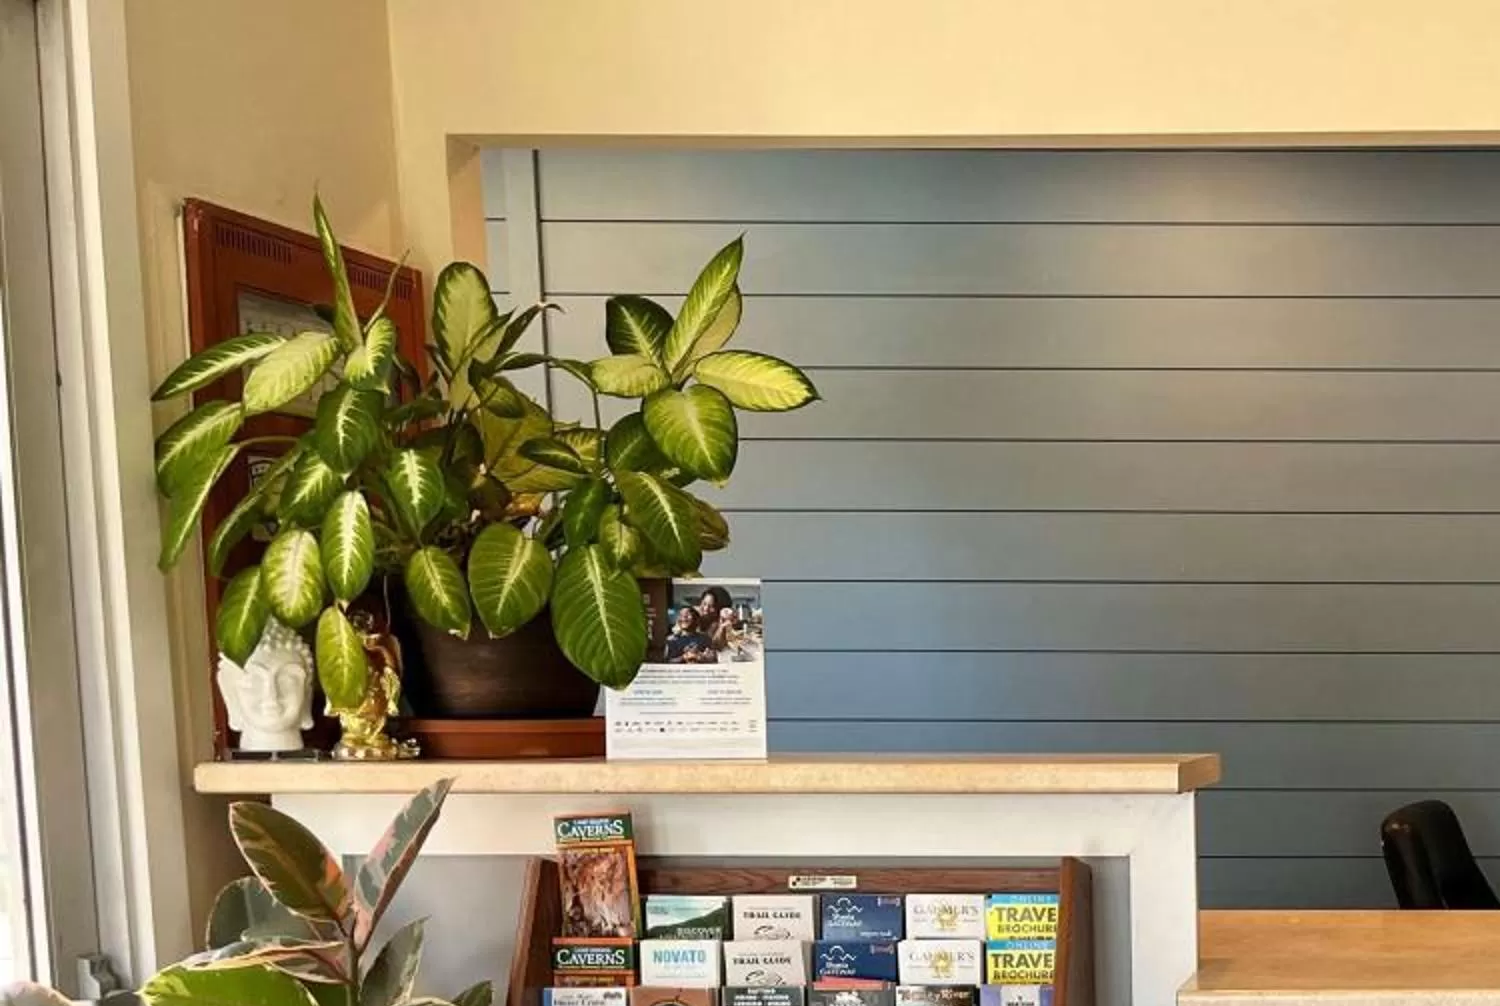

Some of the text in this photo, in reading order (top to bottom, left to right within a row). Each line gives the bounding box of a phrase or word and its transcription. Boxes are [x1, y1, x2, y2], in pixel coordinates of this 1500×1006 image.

[557, 819, 625, 839] CAVERNS
[995, 907, 1056, 923] TRAVE
[556, 949, 625, 965] CAVERNS
[652, 950, 707, 964] NOVATO
[991, 954, 1052, 969] TRAVE
